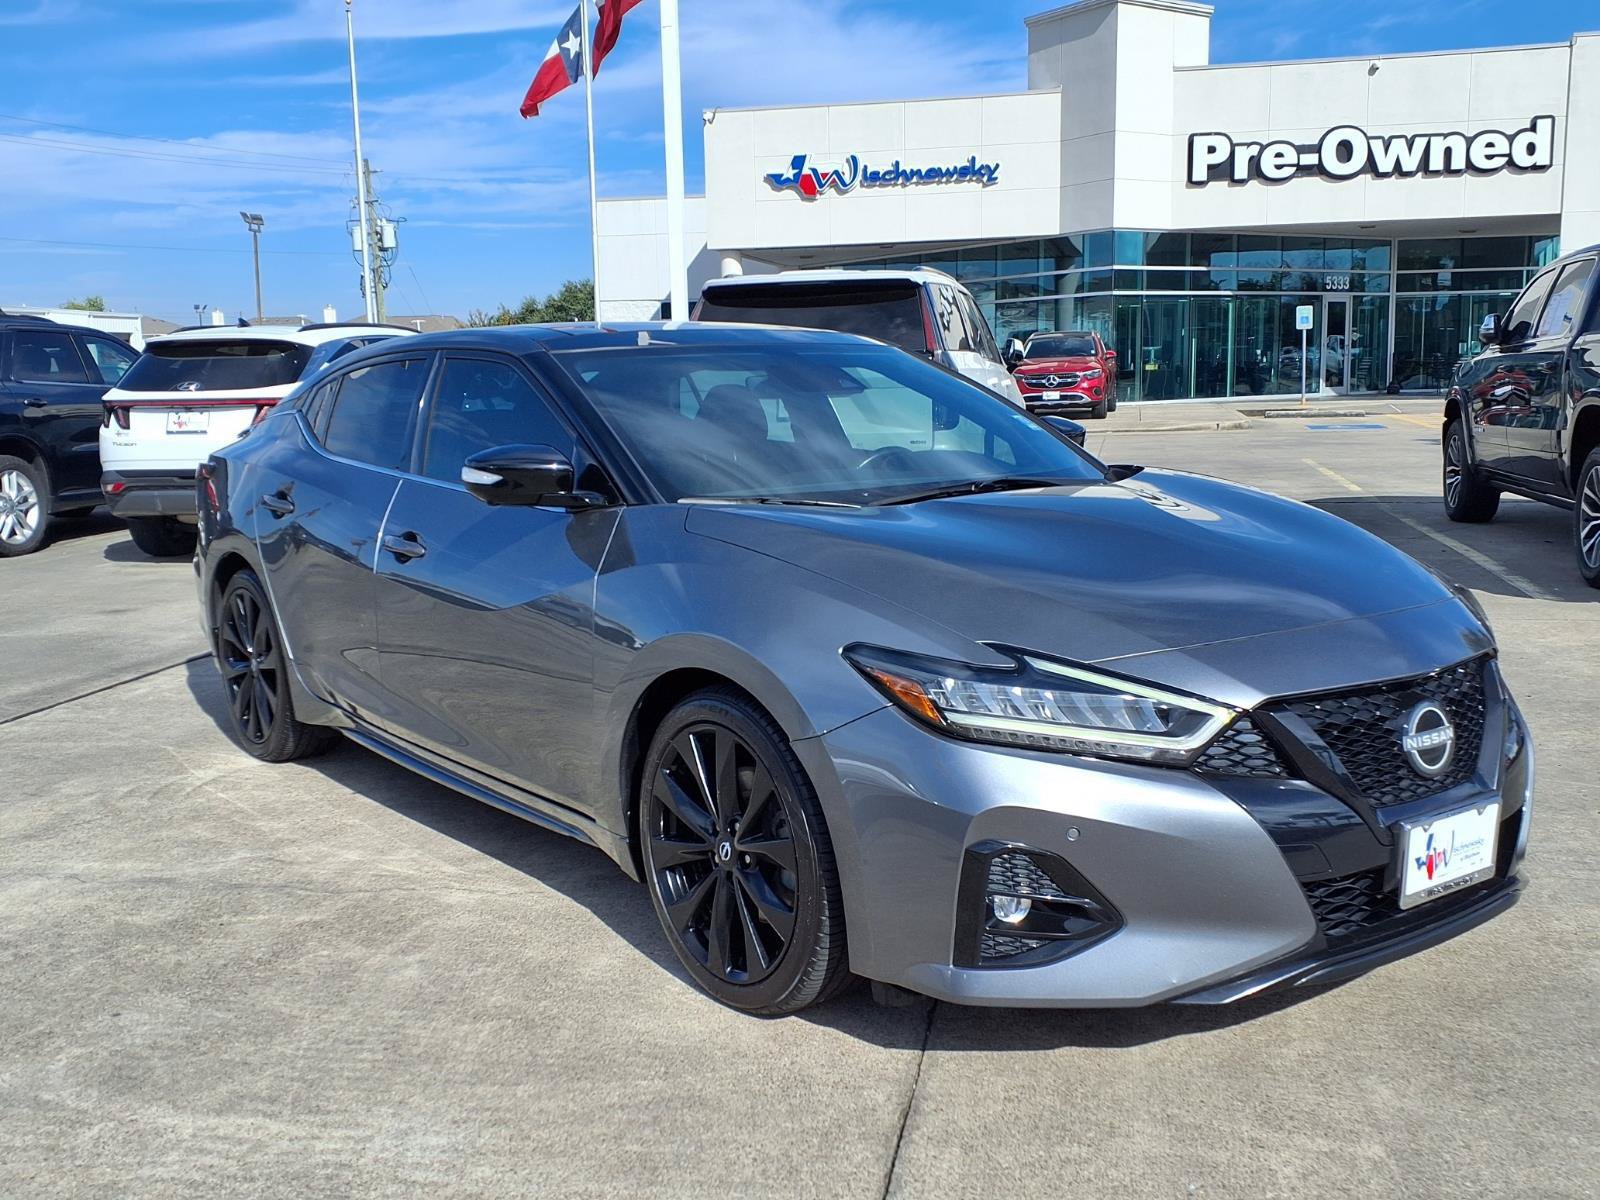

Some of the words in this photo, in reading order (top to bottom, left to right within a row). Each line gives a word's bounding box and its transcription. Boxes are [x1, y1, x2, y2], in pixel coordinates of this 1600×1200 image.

[1189, 115, 1555, 186] Pre-Owned
[1325, 275, 1350, 290] 5333
[1406, 727, 1454, 749] NISSAN
